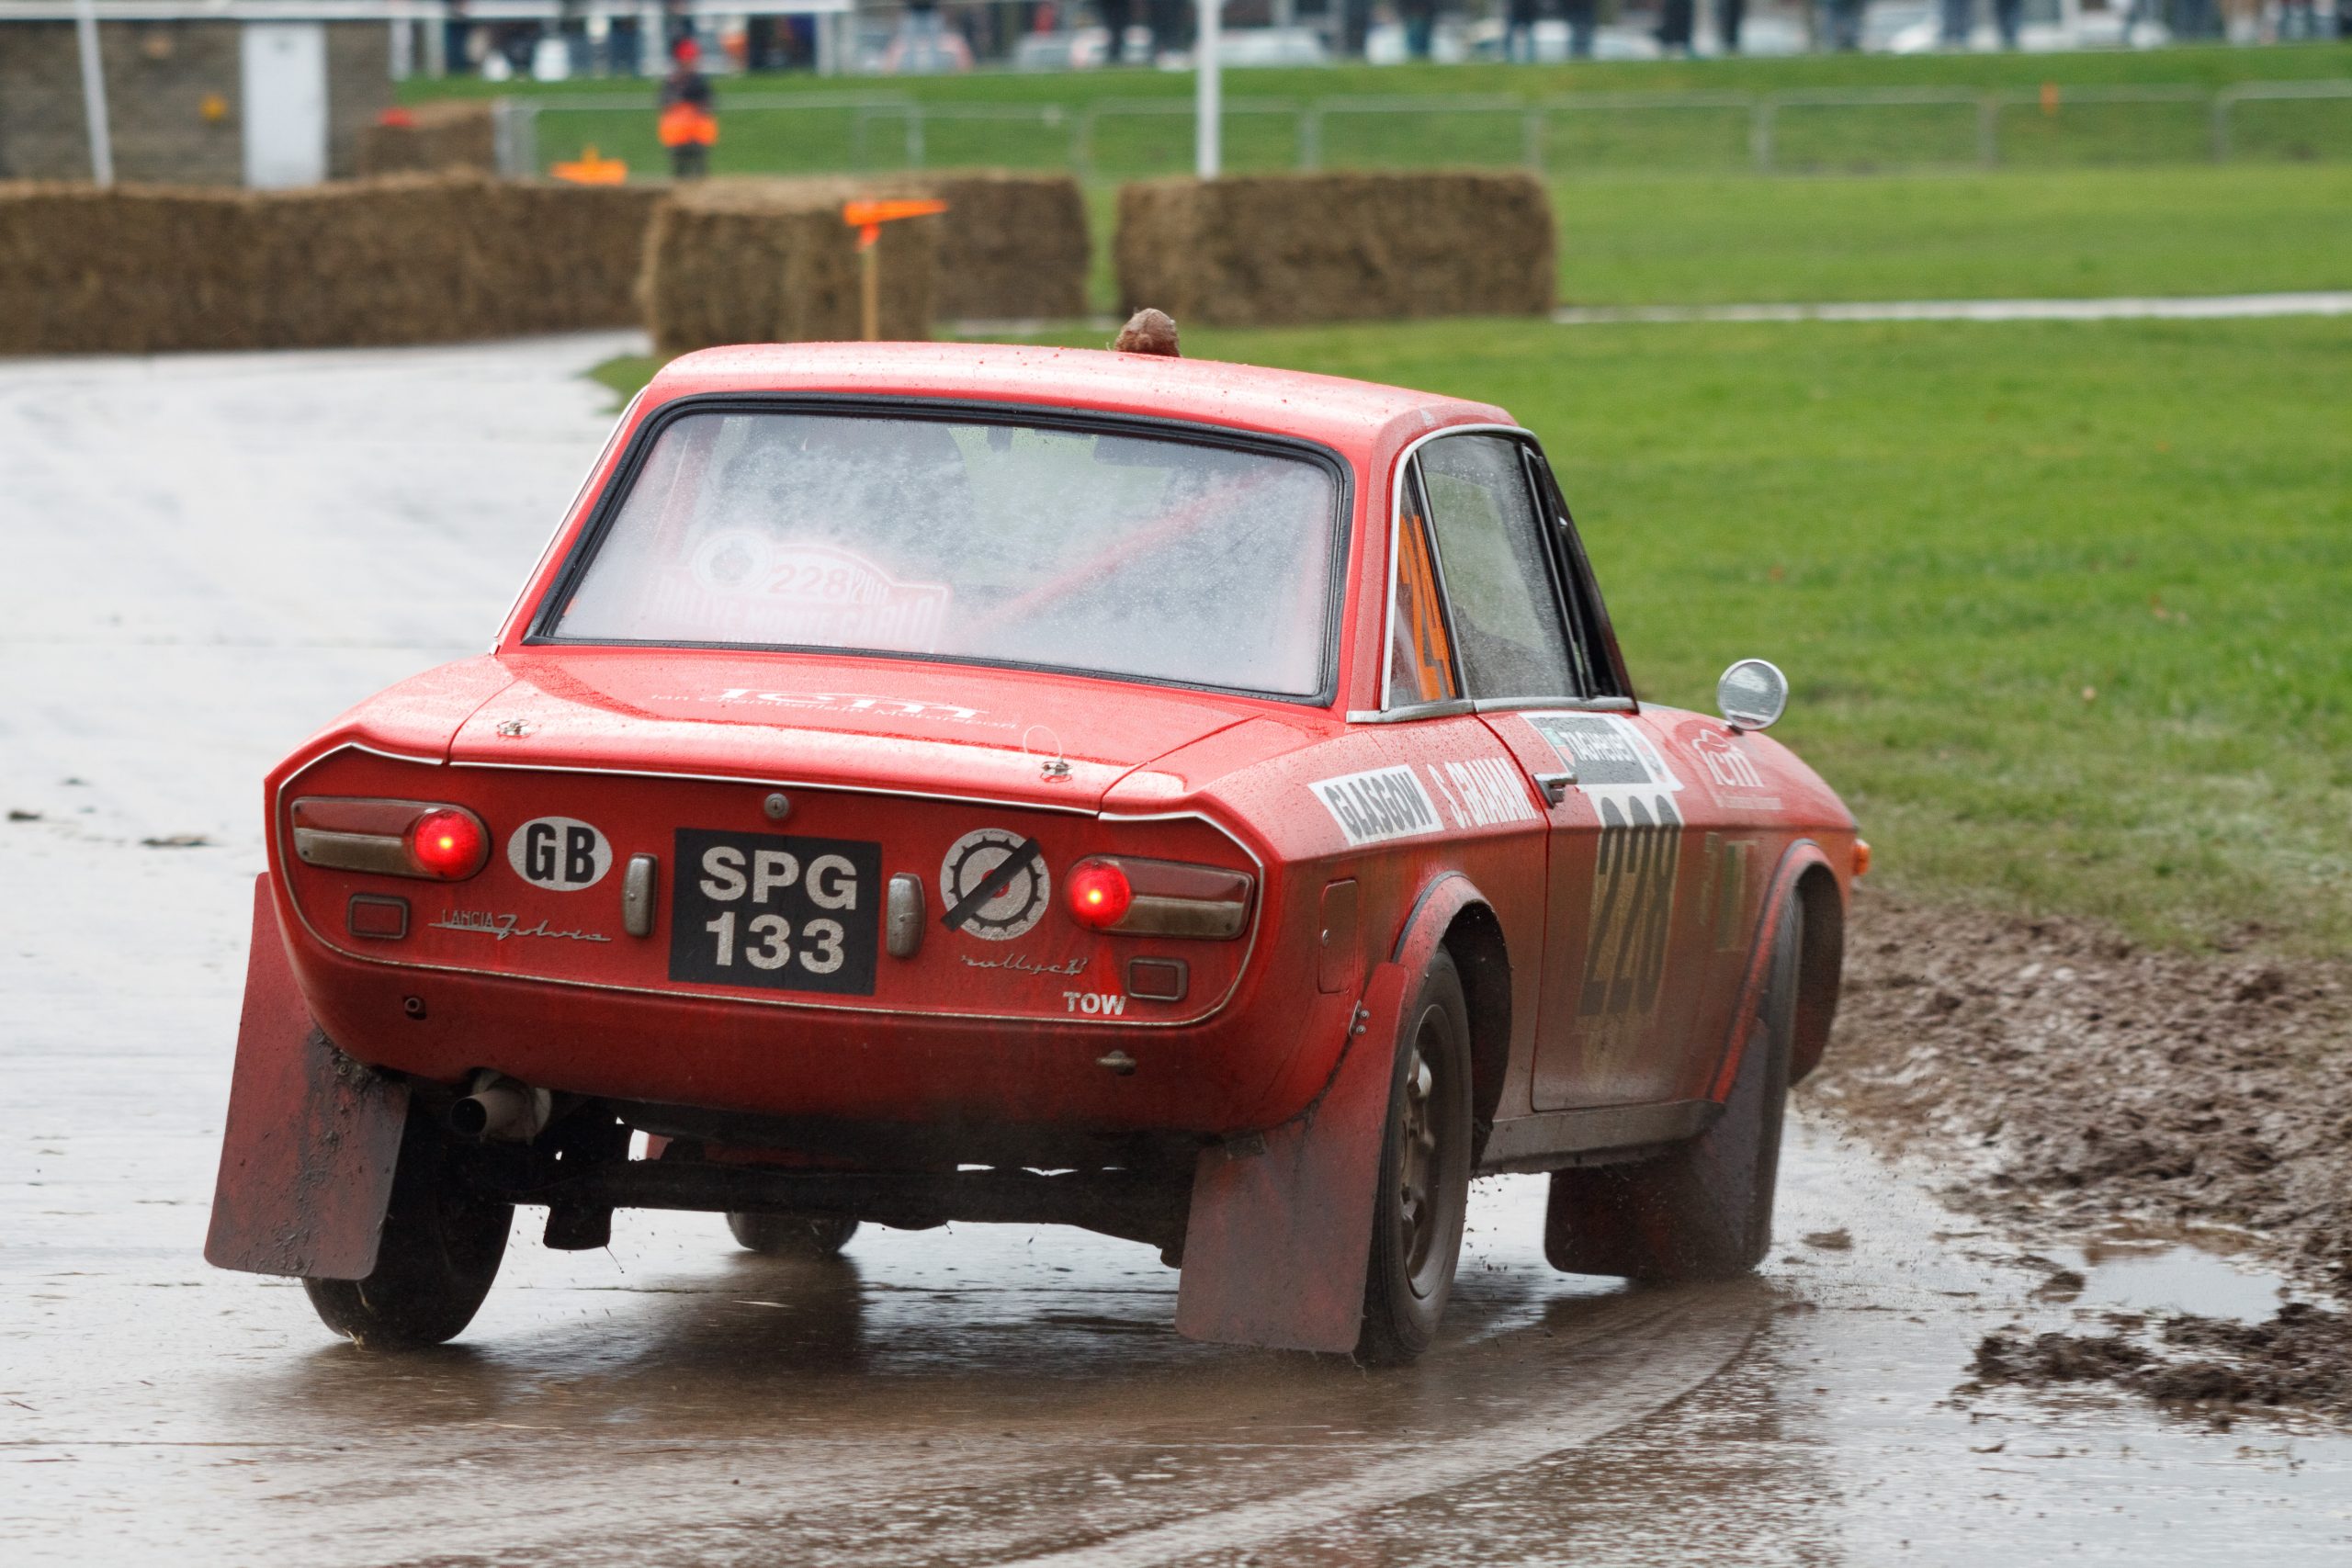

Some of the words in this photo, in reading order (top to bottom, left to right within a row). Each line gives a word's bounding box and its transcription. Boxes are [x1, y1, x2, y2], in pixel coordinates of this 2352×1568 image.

[769, 564, 847, 598] 228
[836, 594, 934, 646] CARLO
[1323, 772, 1433, 840] GLASGOW
[525, 823, 597, 885] GB
[699, 845, 858, 910] SPG
[440, 908, 497, 928] LANCIA
[1578, 795, 1683, 1017] 228
[705, 911, 845, 975] 133
[1062, 991, 1127, 1016] TOW
